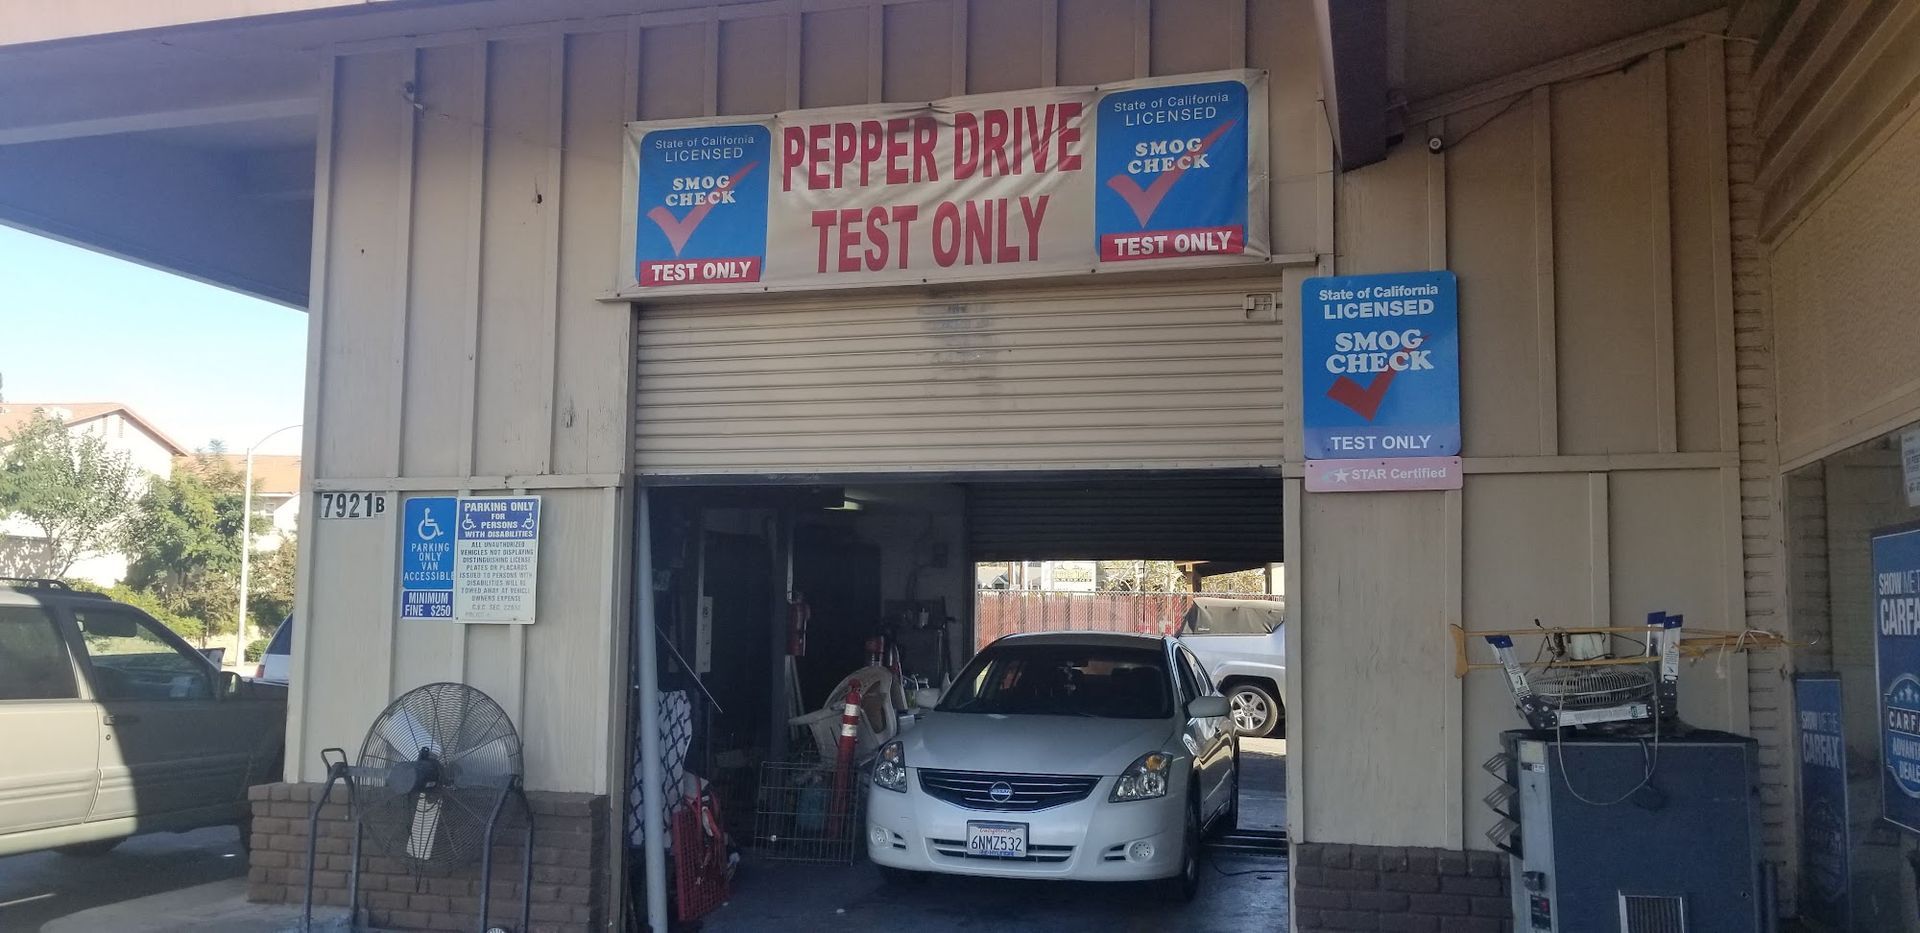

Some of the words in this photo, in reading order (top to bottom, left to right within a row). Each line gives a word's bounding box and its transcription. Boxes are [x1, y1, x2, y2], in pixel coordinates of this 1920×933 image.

[1114, 102, 1146, 112] State
[1151, 98, 1163, 108] of
[1168, 93, 1229, 107] California
[1125, 107, 1217, 127] LICENSED
[655, 139, 683, 150] State
[687, 138, 698, 147] of
[701, 136, 754, 146] California
[783, 116, 938, 192] PEPPER
[954, 102, 1083, 181] DRIVE
[1135, 137, 1203, 157] SMOG
[665, 147, 744, 163] LICENSED
[1127, 154, 1210, 175] CHECK
[672, 175, 730, 191] SMOG
[665, 190, 736, 207] CHECK
[811, 205, 918, 274] TEST
[932, 195, 1050, 268] ONLY
[1114, 236, 1168, 257] TEST
[1174, 230, 1232, 253] ONLY
[651, 263, 698, 282] TEST
[703, 261, 752, 280] ONLY
[1319, 288, 1353, 301] State
[1357, 287, 1371, 299] of
[1373, 284, 1439, 298] California
[1324, 299, 1435, 320] LICENSED
[1335, 328, 1424, 352] SMOG
[1325, 350, 1435, 374] CHECK
[1330, 436, 1377, 450] TEST
[1381, 435, 1432, 449] ONLY
[1351, 469, 1387, 480] STAR
[1390, 467, 1447, 479] Certified
[464, 502, 507, 512] PARKING
[510, 501, 535, 512] ONLY
[481, 521, 518, 529] PERSONS
[488, 530, 533, 538] DISABILITIES
[411, 543, 450, 552] PARKING
[418, 552, 442, 561] ONLY
[421, 562, 438, 571] VAN
[1879, 572, 1902, 595] SHOW
[408, 592, 449, 604] MINIMUM
[404, 605, 423, 617] FINE
[430, 605, 451, 617] $250
[1888, 711, 1920, 733] CARF
[1802, 732, 1840, 769] CARFAX
[971, 835, 1023, 852] 6NMZ532
